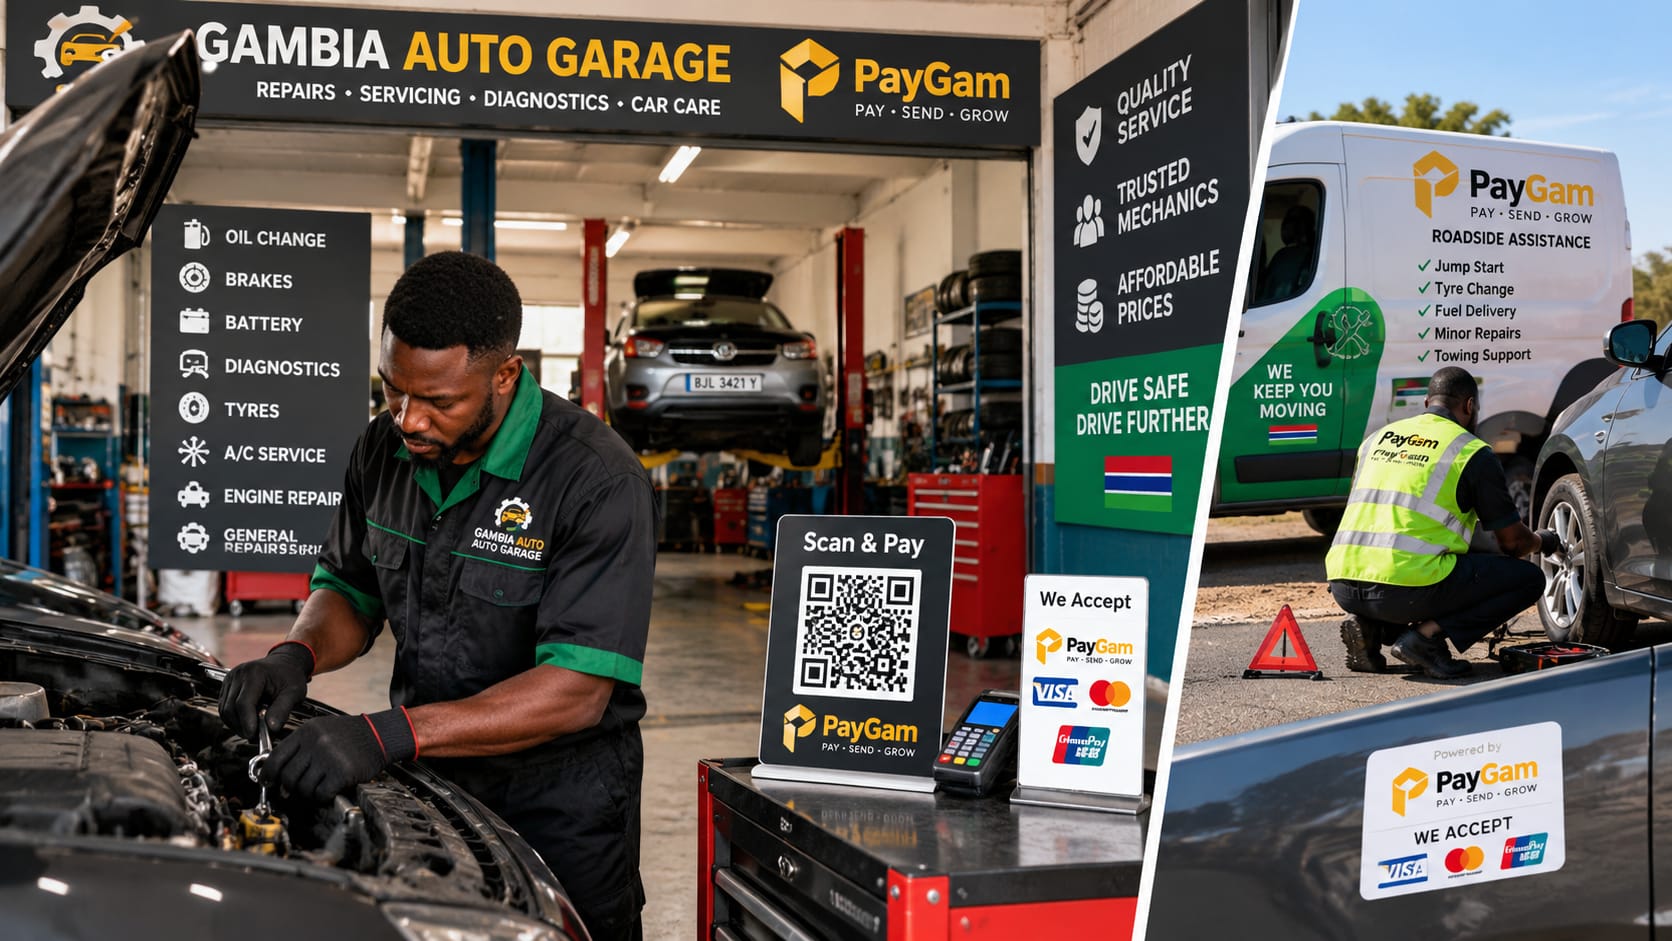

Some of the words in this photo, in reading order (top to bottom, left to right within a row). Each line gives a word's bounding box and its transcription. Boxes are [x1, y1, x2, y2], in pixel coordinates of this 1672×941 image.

[198, 21, 389, 70] GAMBIA
[403, 30, 533, 75] AUTO
[546, 36, 731, 83] GARAGE
[855, 58, 1010, 102] PayGam
[1117, 54, 1192, 116] QUALITY
[256, 81, 336, 101] REPAIRS
[359, 84, 461, 106] SERVICING
[484, 90, 609, 112] DIAGNOSTICS
[631, 96, 669, 114] CAR
[674, 97, 721, 116] CARE
[855, 103, 885, 118] PAY
[902, 105, 944, 120] SEND
[960, 108, 1009, 123] GROW
[1118, 87, 1192, 145] SERVICE
[1117, 157, 1190, 205] TRUSTED
[1470, 168, 1594, 207] PayGam
[1118, 178, 1219, 235] MECHANICS
[1470, 207, 1495, 218] PAY
[1508, 209, 1541, 221] SEND
[1554, 212, 1593, 224] GROW
[225, 229, 253, 245] OIL
[257, 230, 326, 248] CHANGE
[1432, 229, 1504, 246] ROADSIDE
[1508, 232, 1591, 249] ASSISTANCE
[1117, 249, 1220, 295] AFFORDABLE
[1434, 260, 1471, 276] Jump
[1473, 260, 1505, 274] Start
[225, 272, 293, 289] BRAKES
[1435, 281, 1463, 298] Tyre
[1467, 282, 1515, 299] Change
[1118, 293, 1173, 325] PRICES
[1435, 304, 1462, 317] Fuel
[1466, 304, 1517, 320] Delivery
[225, 315, 303, 332] BATTERY
[1435, 327, 1472, 340] Minor
[1475, 327, 1521, 342] Repairs
[1434, 349, 1479, 364] Towing
[1482, 348, 1532, 363] Support
[225, 358, 341, 378] DIAGNOSTICS
[1267, 364, 1292, 380] WE
[694, 377, 715, 388] BJL
[719, 378, 746, 389] 3421
[750, 378, 757, 389] Y
[1090, 378, 1138, 405] DRIVE
[1143, 372, 1189, 401] SAFE
[1253, 383, 1294, 400] KEEP
[1299, 382, 1333, 398] YOU
[224, 402, 280, 418] TYRES
[1259, 402, 1326, 419] MOVING
[1076, 411, 1122, 436] DRIVE
[1127, 405, 1209, 434] FURTHER
[224, 445, 254, 462] A/C
[258, 446, 326, 463] SERVICE
[224, 488, 283, 505] ENGINE
[287, 490, 343, 506] REPAIR
[223, 528, 298, 543] GENERAL
[474, 527, 514, 545] GAMBIA
[516, 536, 545, 551] AUTO
[803, 531, 855, 553] Scan
[861, 532, 877, 553] &
[884, 533, 925, 559] Pay
[471, 539, 498, 552] AUTO
[500, 545, 543, 561] GARAGE
[1039, 591, 1067, 607] We
[1071, 592, 1132, 612] Accept
[1067, 637, 1133, 656] PayGam
[1109, 657, 1133, 665] GROW
[1034, 682, 1077, 703] VISA
[823, 714, 918, 744] PayGam
[821, 742, 840, 752] PAY
[848, 744, 875, 755] SEND
[884, 747, 916, 757] GROW
[1433, 743, 1485, 761] Powered
[1488, 742, 1502, 754] by
[1437, 760, 1538, 793] PayGam
[1436, 797, 1455, 808] PAY
[1466, 792, 1493, 804] SEND
[1504, 784, 1538, 797] GROW
[1414, 828, 1440, 845] WE
[1445, 816, 1513, 840] ACCEPT
